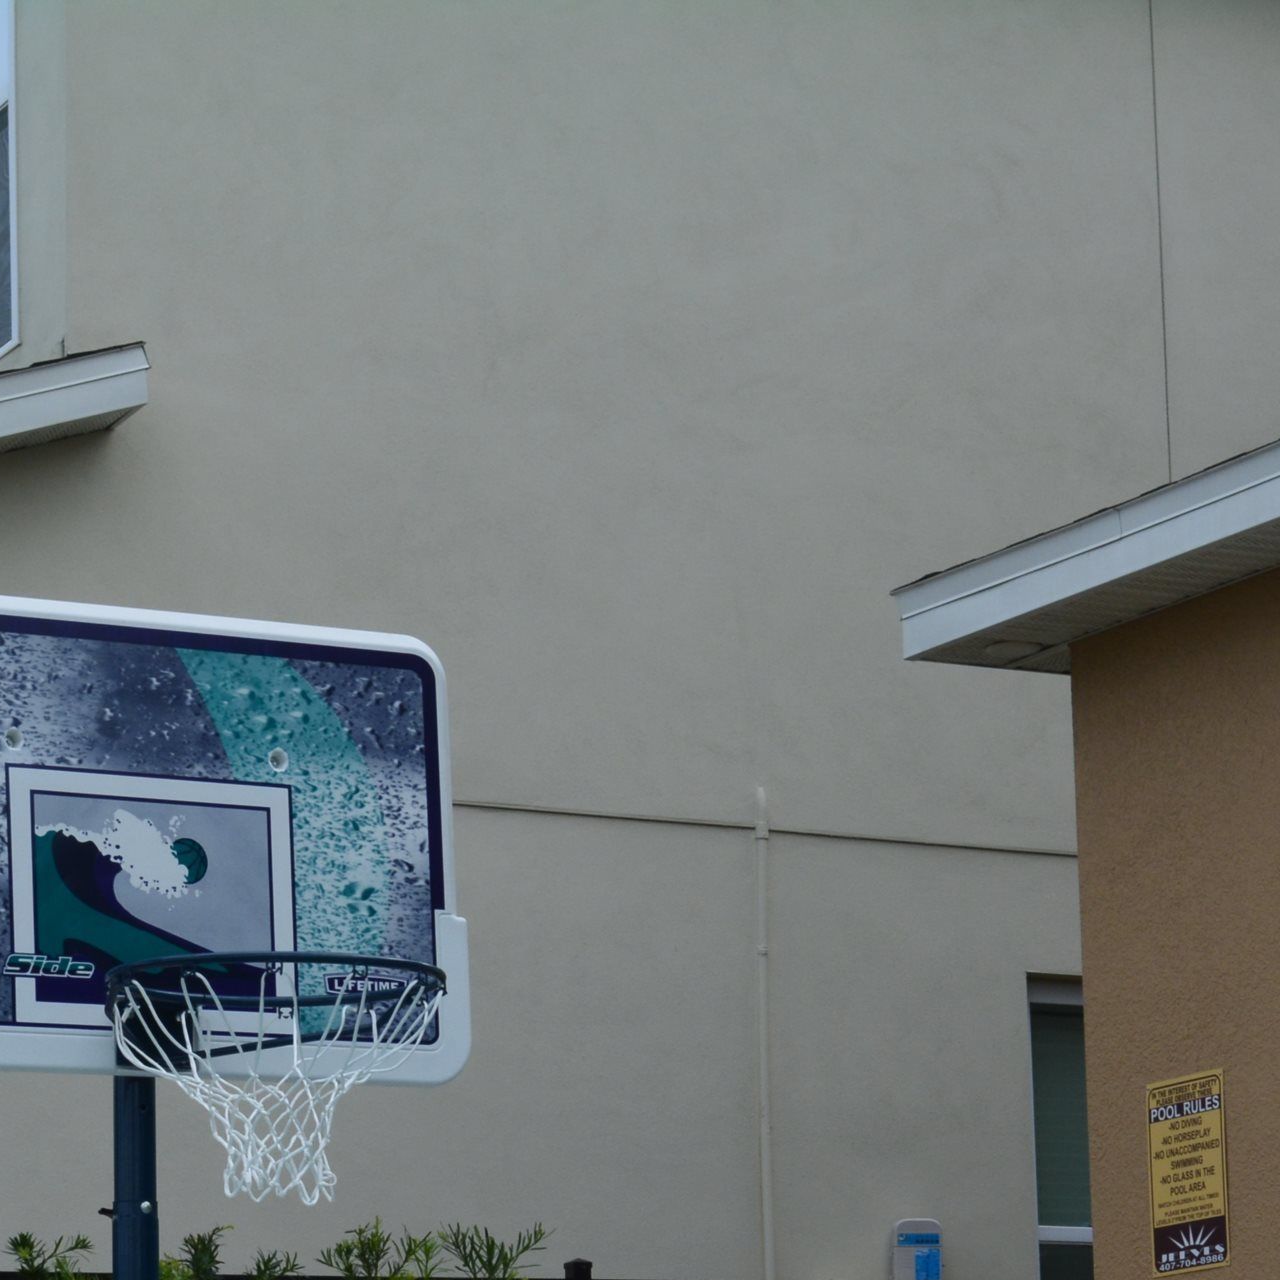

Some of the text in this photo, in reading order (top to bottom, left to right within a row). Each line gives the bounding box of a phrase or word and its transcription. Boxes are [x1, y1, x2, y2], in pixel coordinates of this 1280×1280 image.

[3, 953, 95, 978] Side
[1199, 1079, 1217, 1088] SAFETY
[1151, 1095, 1220, 1123] POOL RULES
[1181, 1116, 1202, 1129] DIVING
[1174, 1127, 1211, 1143] HORSEPLAY
[1166, 1139, 1220, 1157] UNACCOMPANIED
[1171, 1155, 1203, 1170] SWIMMING
[1172, 1170, 1194, 1183] GLASS
[1194, 1168, 1201, 1178] IN
[1203, 1165, 1216, 1176] THE
[1170, 1181, 1206, 1196] POOL AREA
[1159, 1254, 1224, 1271] 407-704-8986
